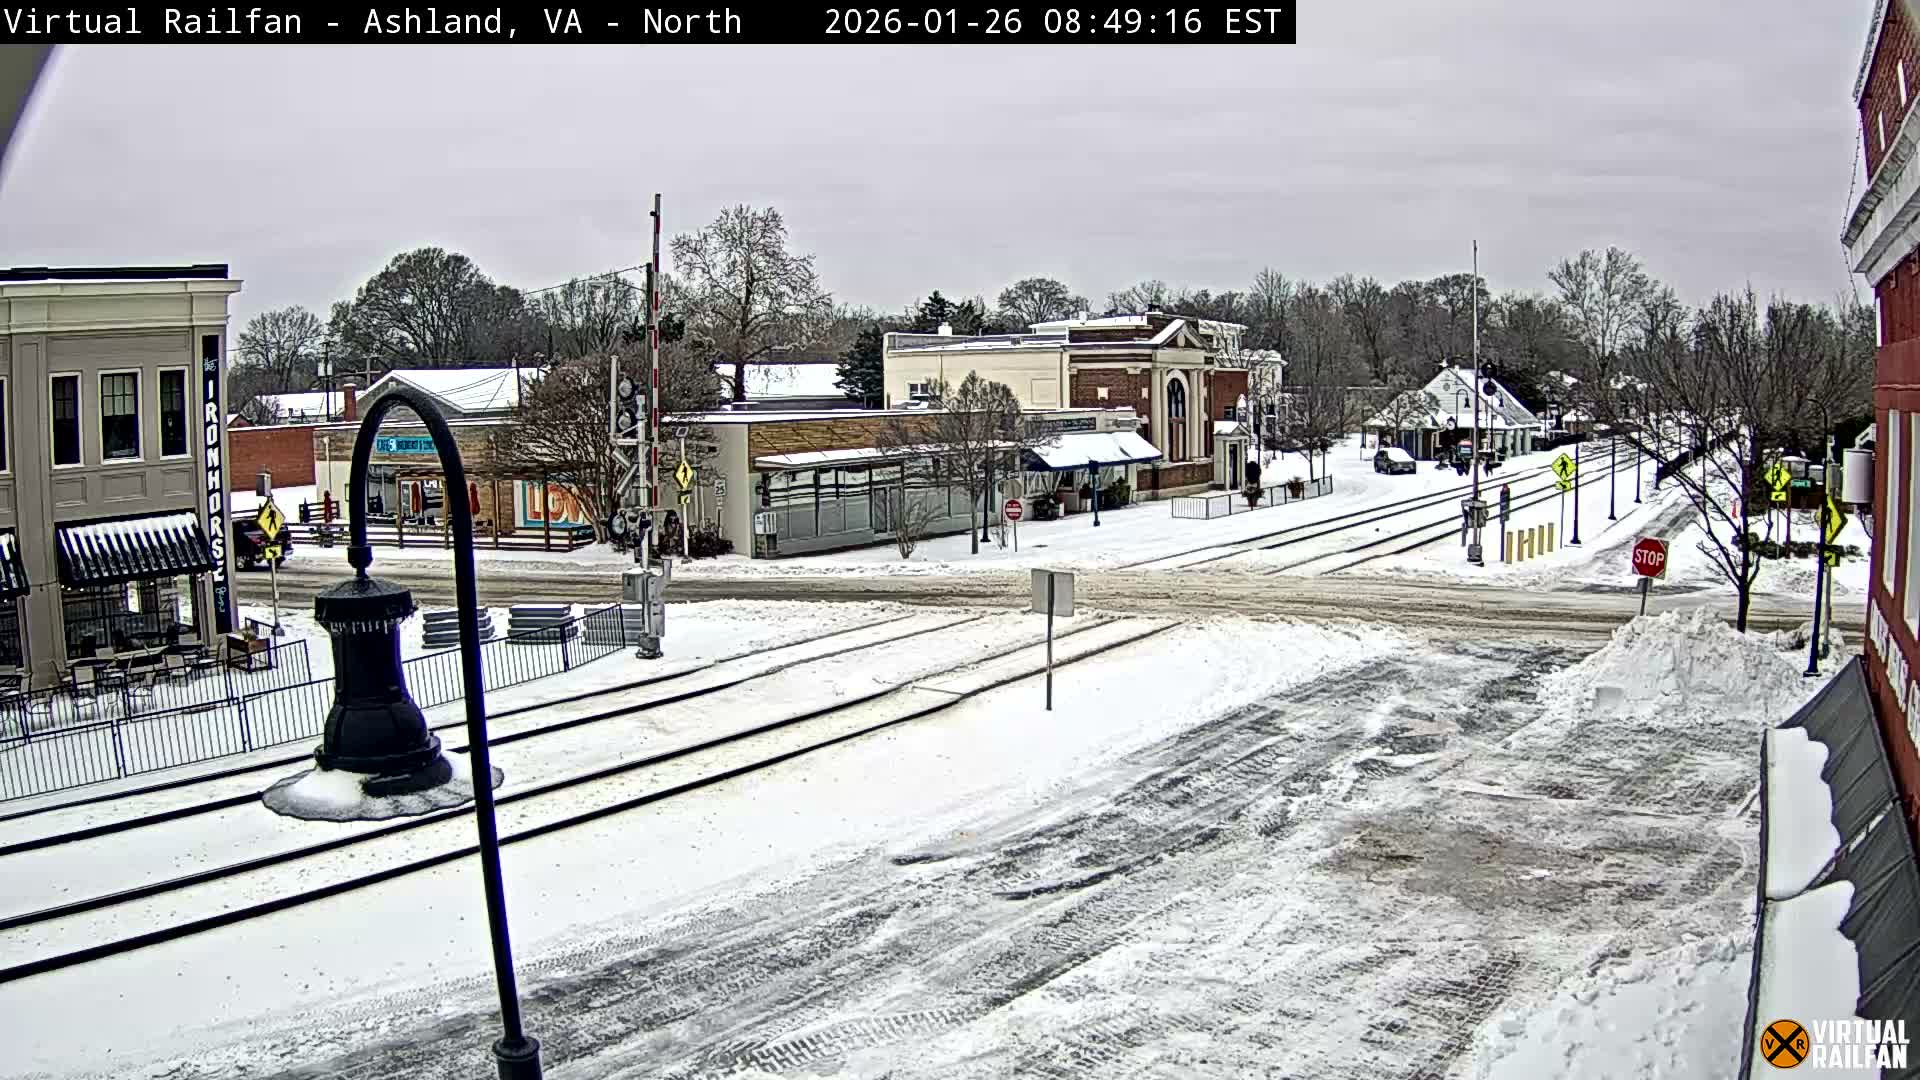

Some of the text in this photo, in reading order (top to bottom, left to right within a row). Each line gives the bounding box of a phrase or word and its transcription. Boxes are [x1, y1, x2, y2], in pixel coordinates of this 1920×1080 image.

[204, 379, 225, 582] IRONHORSE
[715, 485, 725, 495] 25
[1634, 548, 1665, 567] STOP
